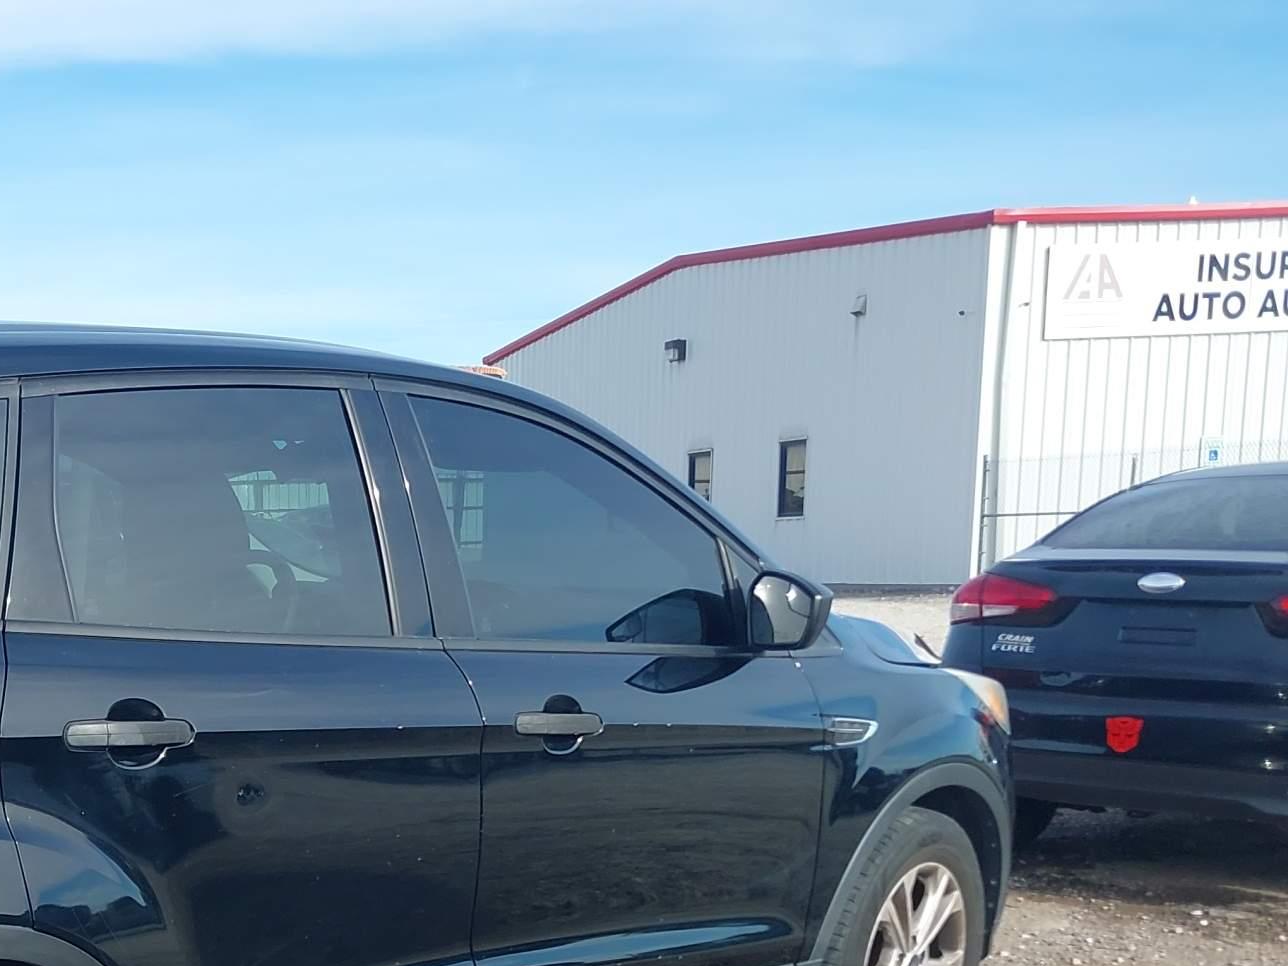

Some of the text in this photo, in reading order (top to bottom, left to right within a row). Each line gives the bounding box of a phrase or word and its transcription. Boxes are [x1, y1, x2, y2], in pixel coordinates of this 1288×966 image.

[1152, 289, 1288, 322] AUTO A
[998, 633, 1035, 643] CRAIN
[992, 643, 1036, 654] FORTE
